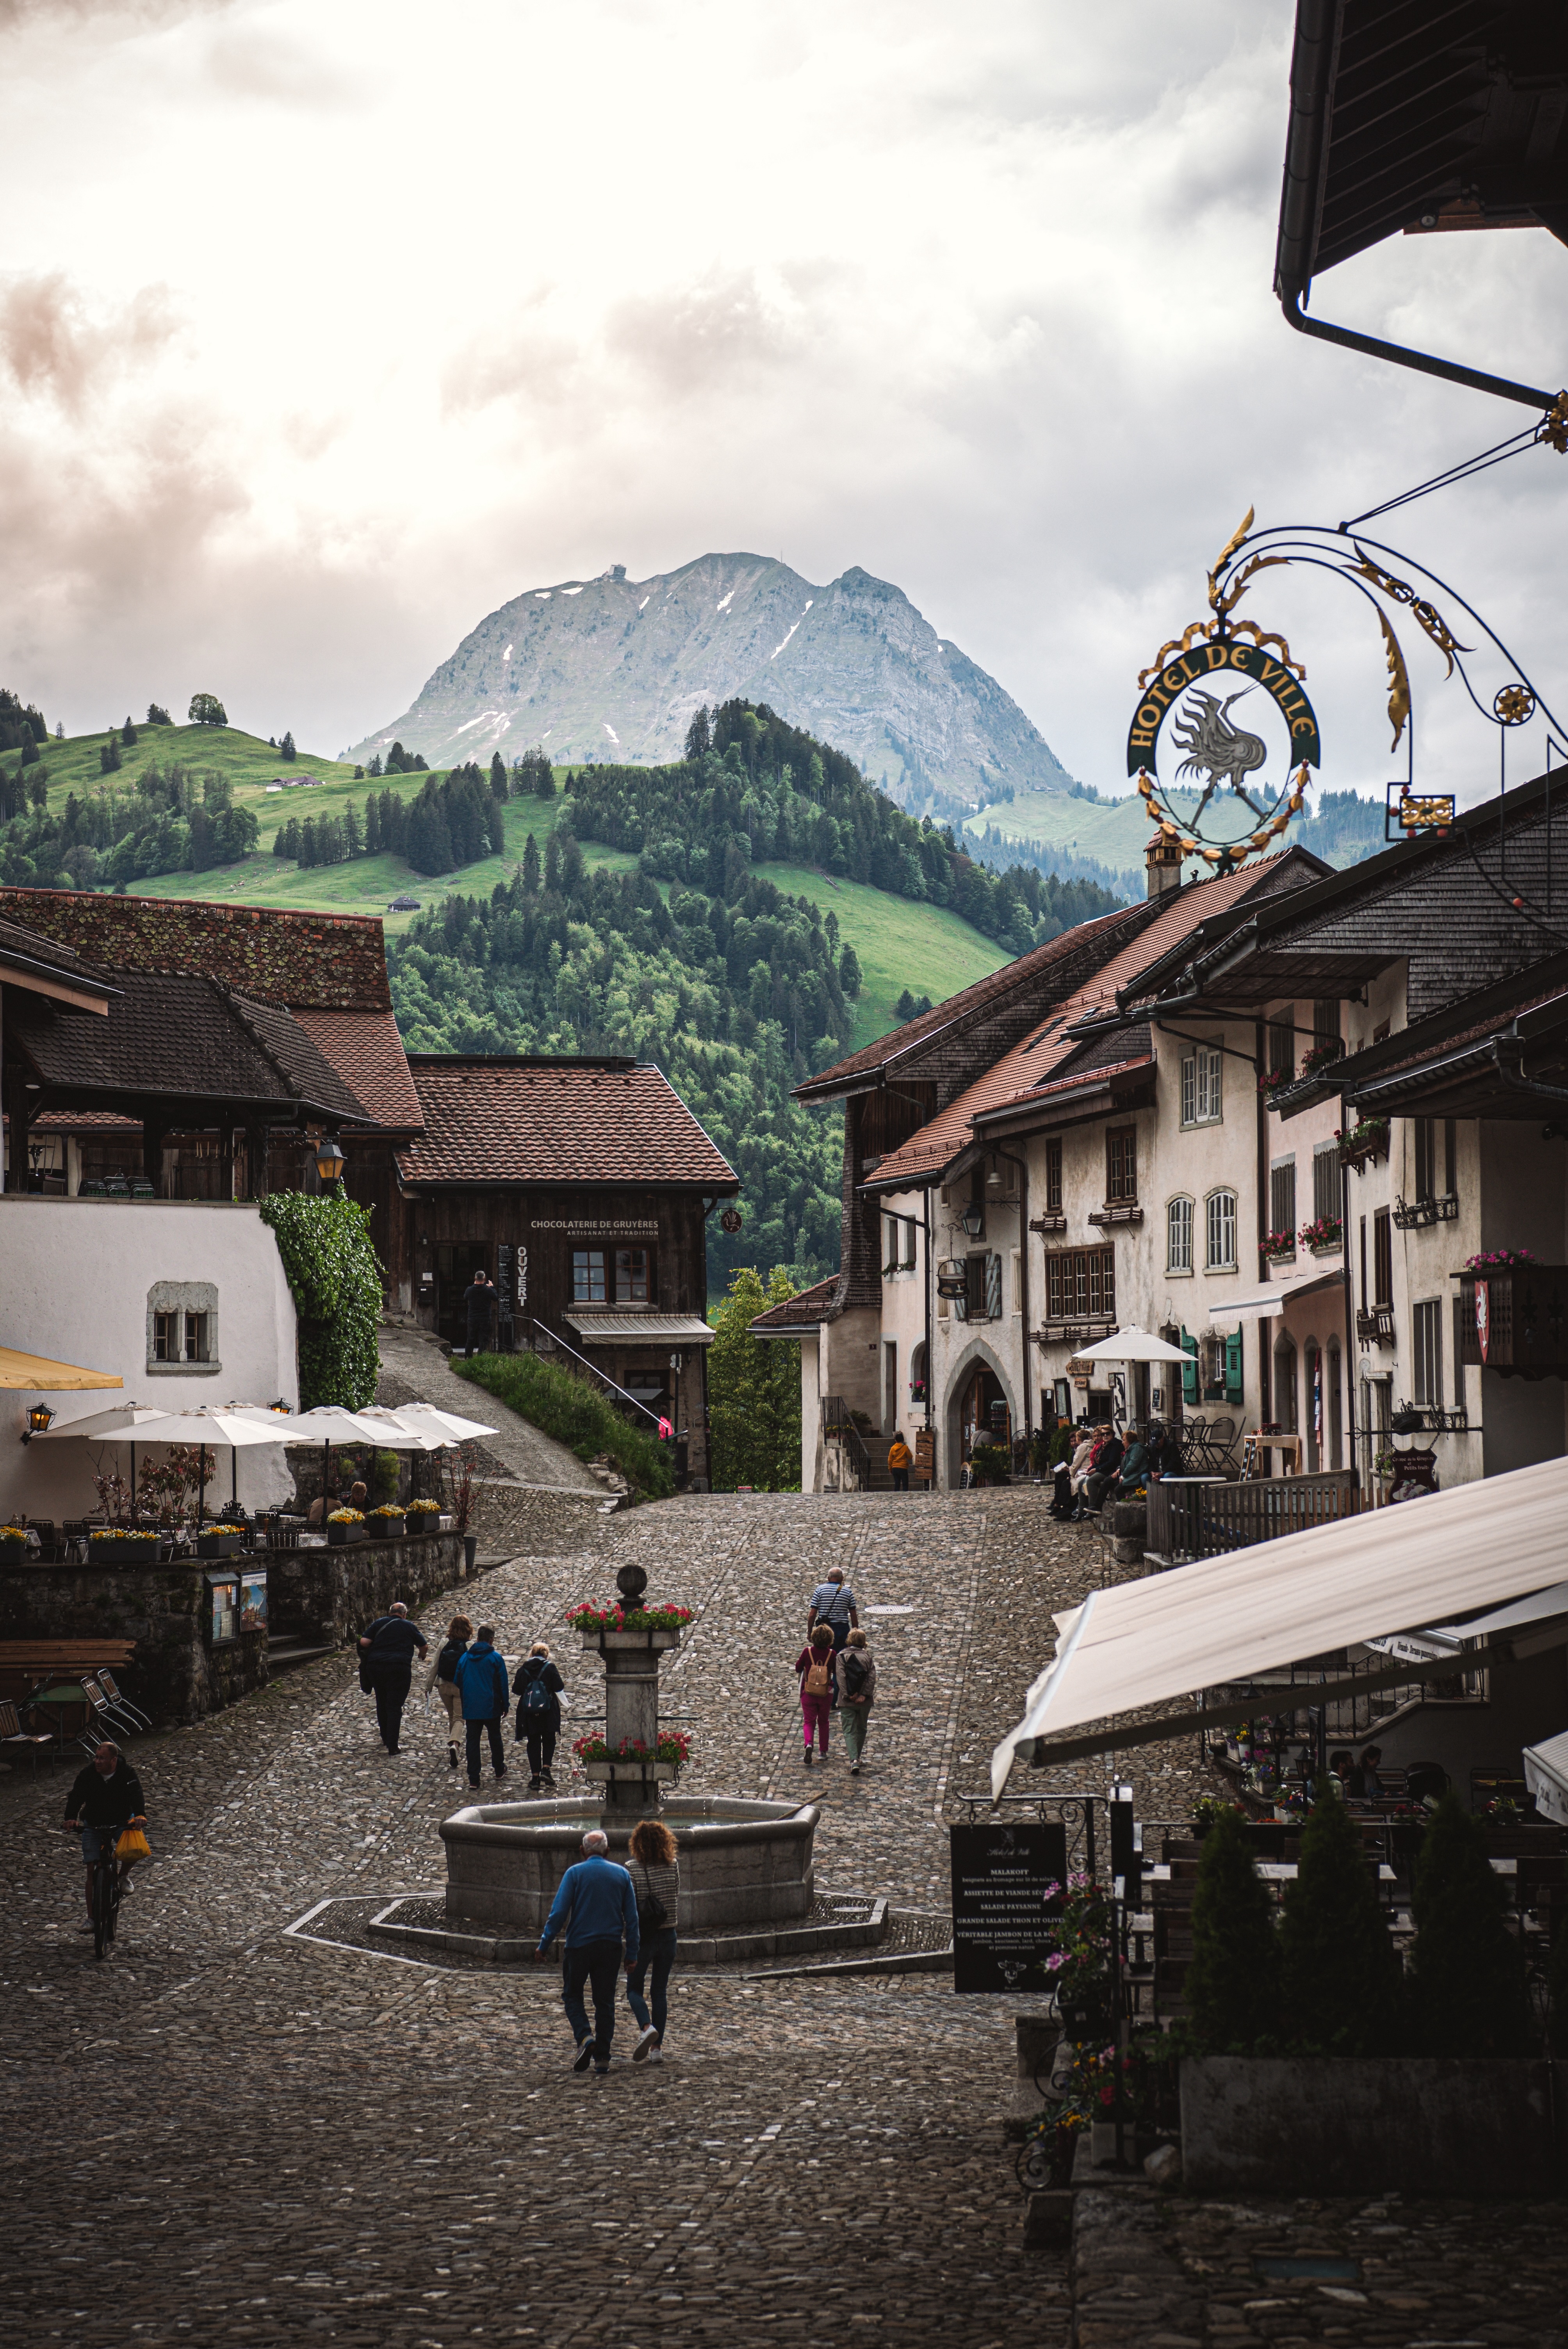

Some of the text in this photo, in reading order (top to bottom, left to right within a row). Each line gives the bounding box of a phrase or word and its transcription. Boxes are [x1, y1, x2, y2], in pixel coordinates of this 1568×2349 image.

[1131, 646, 1317, 747] HOTEL DE VILLE
[613, 1219, 658, 1228] GRUYÈRES
[517, 1247, 527, 1306] OUVERT
